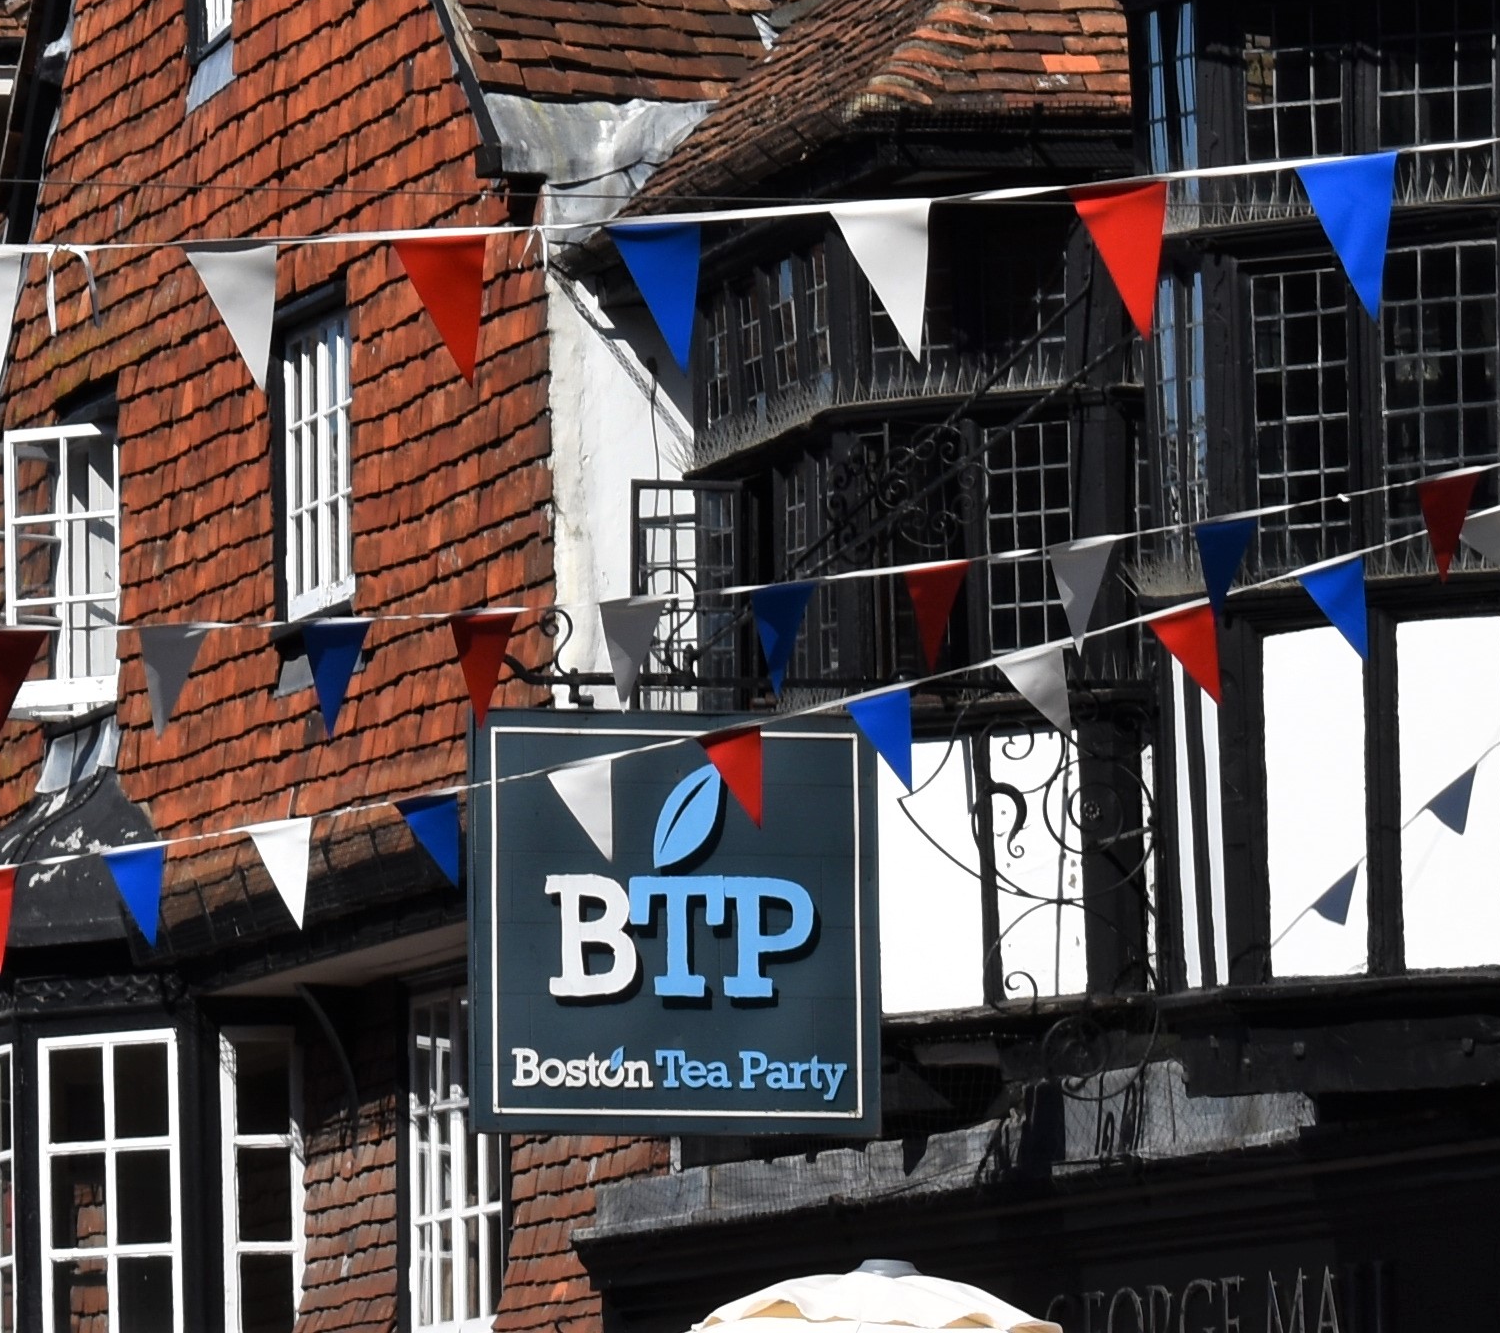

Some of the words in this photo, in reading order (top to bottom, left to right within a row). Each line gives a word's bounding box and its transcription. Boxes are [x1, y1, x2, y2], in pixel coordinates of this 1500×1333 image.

[544, 873, 815, 998] BTP
[511, 1046, 654, 1089] Boston
[655, 1048, 732, 1089] Tea
[738, 1050, 848, 1102] Party
